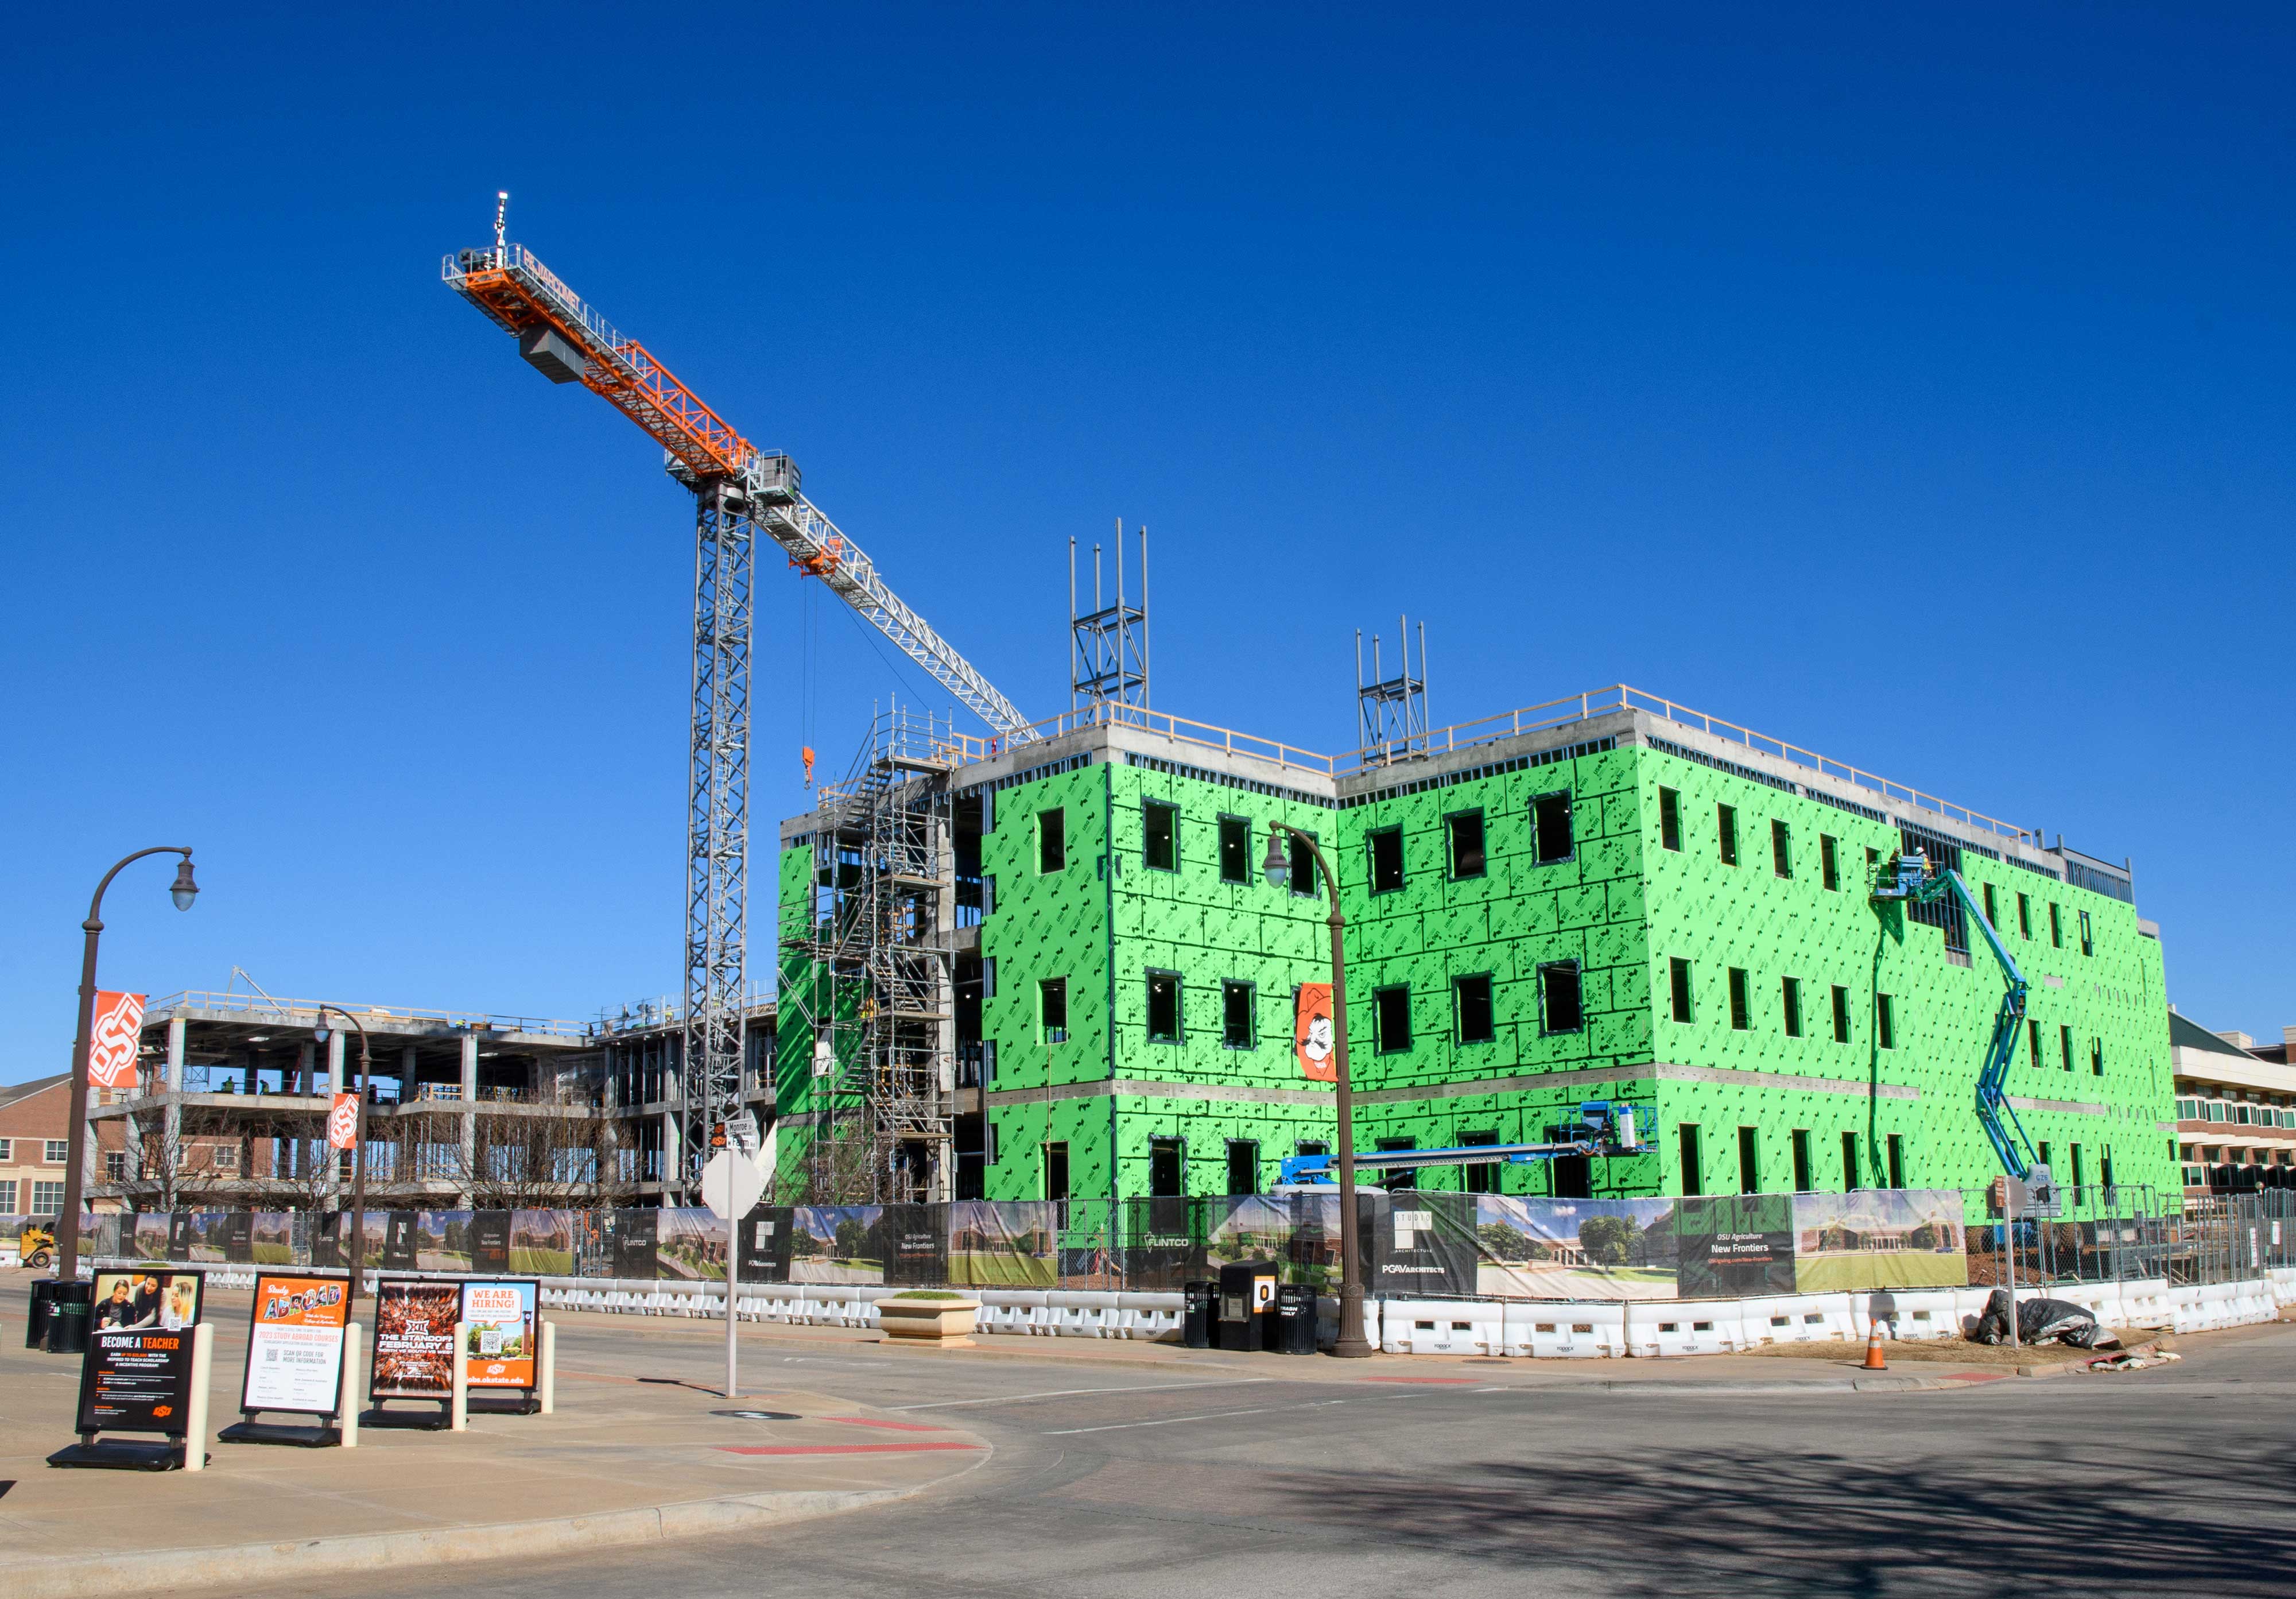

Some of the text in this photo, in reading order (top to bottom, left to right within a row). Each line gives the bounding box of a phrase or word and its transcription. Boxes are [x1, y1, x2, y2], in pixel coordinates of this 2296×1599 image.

[331, 1094, 359, 1148] OSU
[730, 1122, 747, 1132] Monroe
[711, 1136, 726, 1147] OSU
[1731, 1233, 1763, 1241] Agriculture
[1148, 1238, 1189, 1247] FLINTCO
[1711, 1243, 1768, 1253] New Frontiers
[267, 1284, 289, 1295] Study
[492, 1291, 514, 1299] ARE
[263, 1284, 342, 1320] ABROAD
[472, 1300, 514, 1308] HIRING!
[292, 1333, 313, 1341] ABROAD
[315, 1334, 339, 1342] COURSES
[102, 1336, 180, 1350] BECOME A TEACHER
[379, 1341, 442, 1349] FEBRUARY
[486, 1364, 506, 1375] OSU
[153, 1405, 173, 1418] OSU
